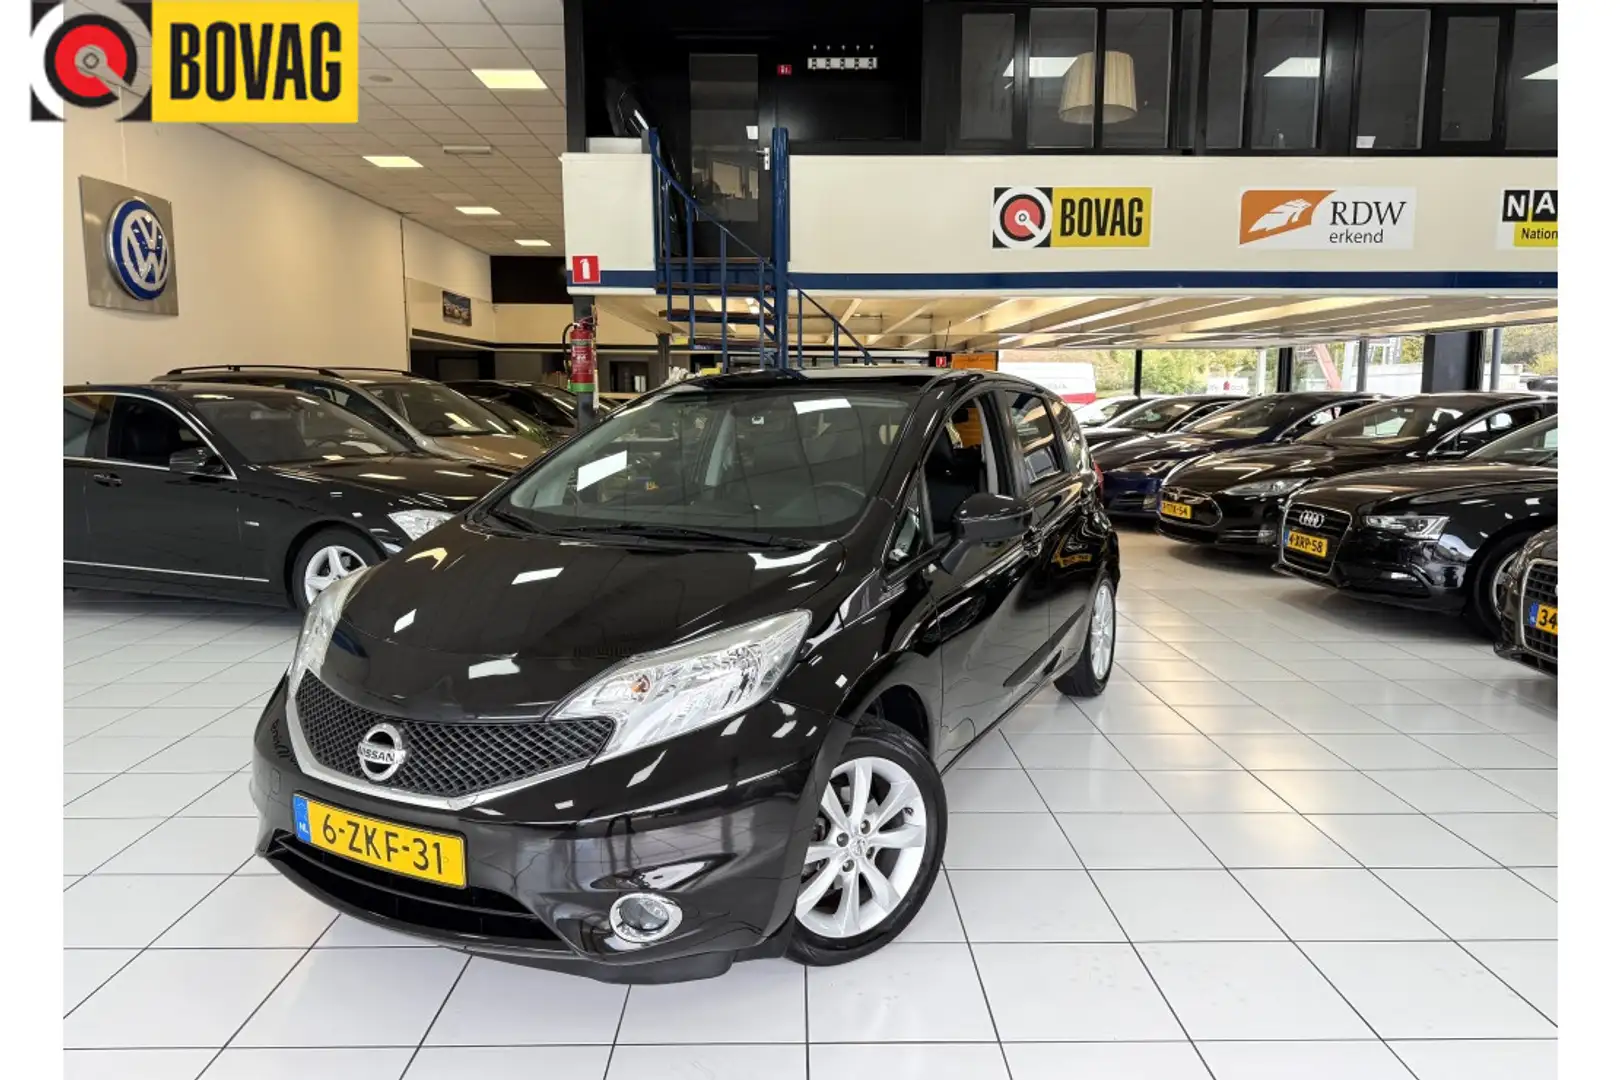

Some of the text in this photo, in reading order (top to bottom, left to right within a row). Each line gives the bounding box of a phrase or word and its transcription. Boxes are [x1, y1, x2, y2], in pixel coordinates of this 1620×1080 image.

[1059, 197, 1144, 238] BOVAG
[1329, 201, 1408, 226] RDW
[1328, 228, 1385, 244] erkend
[358, 745, 396, 763] NISSAN
[298, 814, 443, 876] NL 6-ZKF-31
